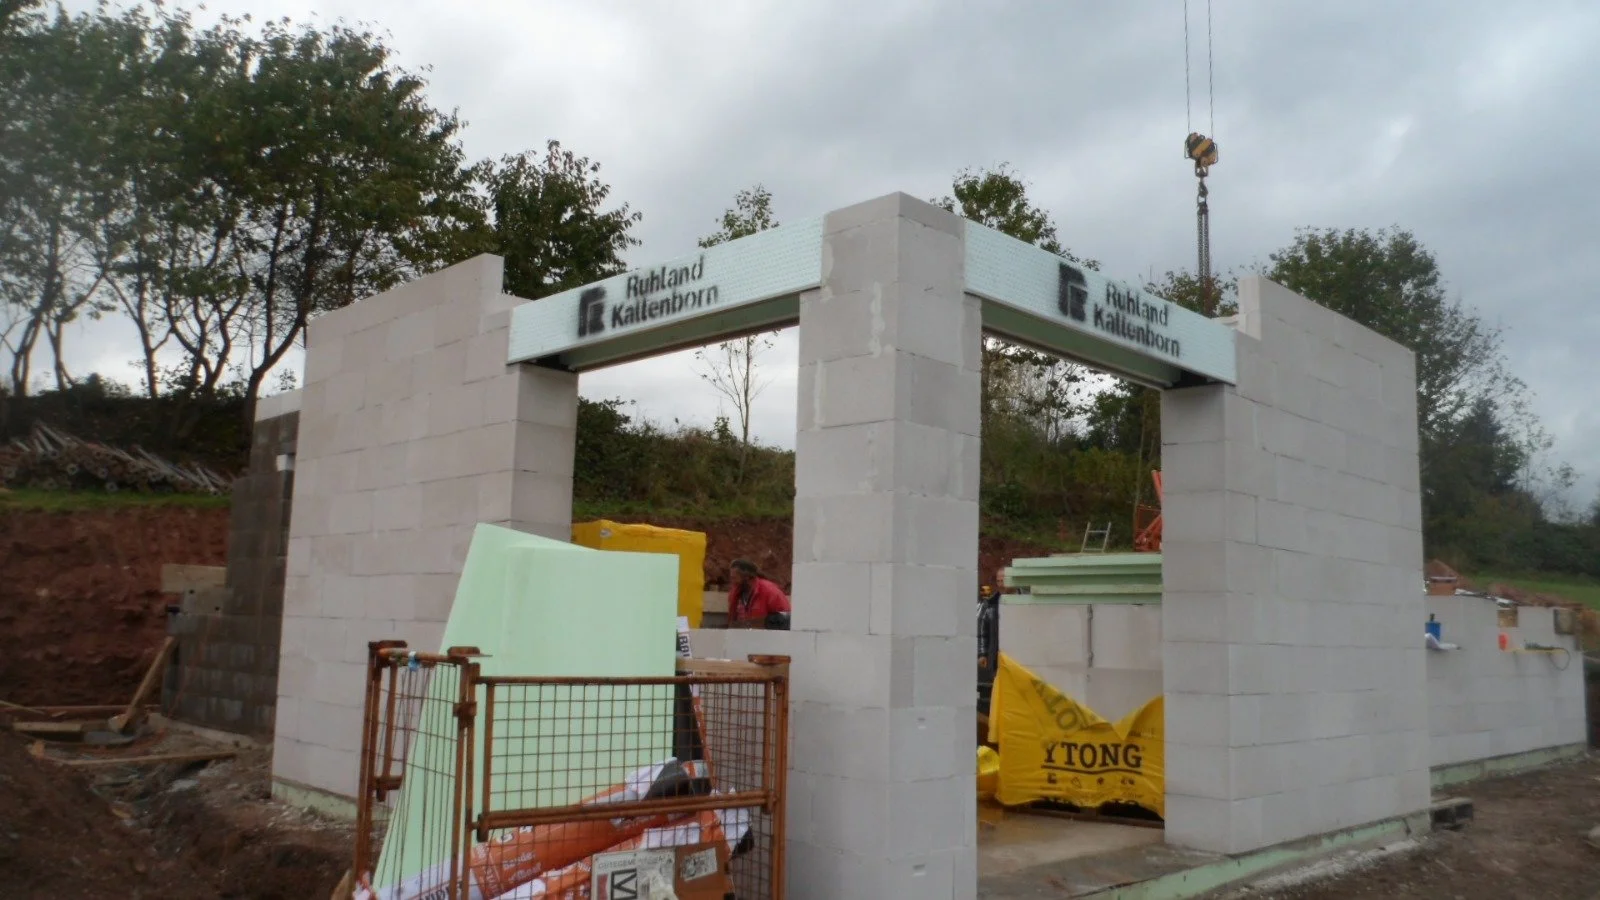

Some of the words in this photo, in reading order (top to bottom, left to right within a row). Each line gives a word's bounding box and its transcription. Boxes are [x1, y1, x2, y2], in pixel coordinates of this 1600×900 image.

[627, 255, 704, 299] Ruhland
[1106, 283, 1168, 326] Ruhland
[1043, 741, 1142, 768] YTONG
